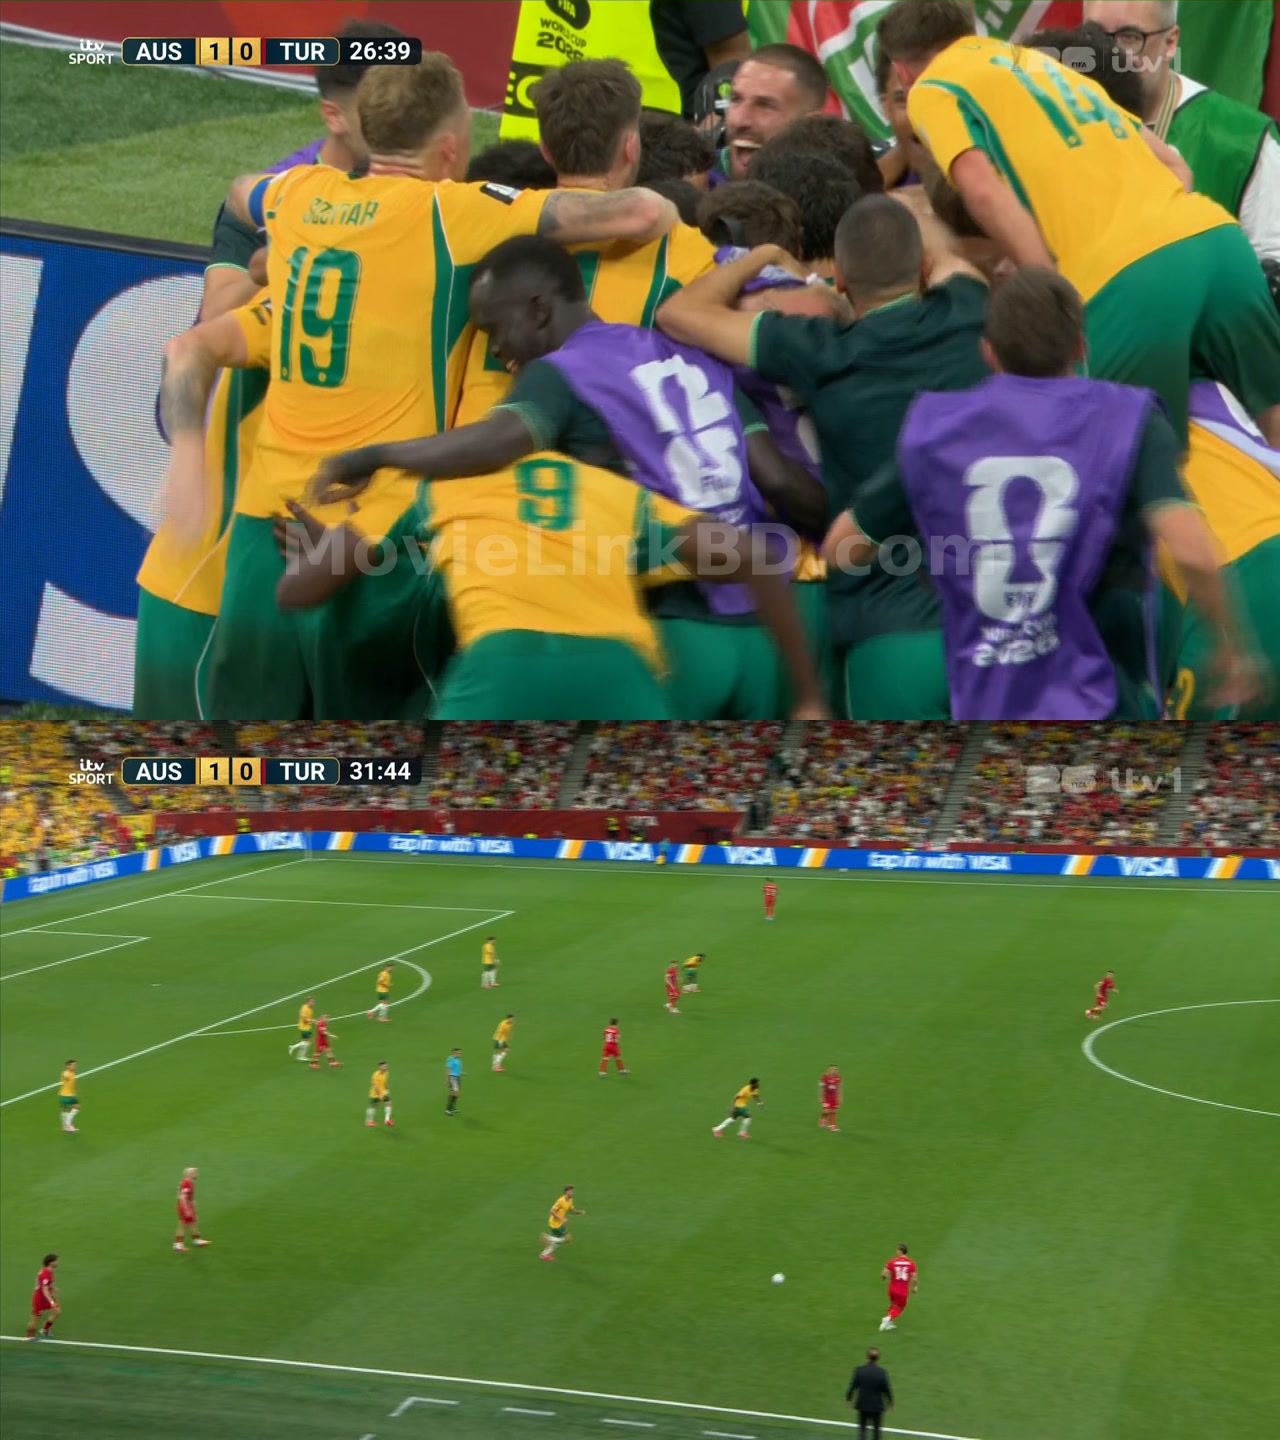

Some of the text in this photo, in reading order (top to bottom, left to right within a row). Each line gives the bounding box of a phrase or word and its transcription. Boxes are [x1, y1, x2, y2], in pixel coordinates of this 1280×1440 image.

[570, 34, 587, 49] CUP
[990, 55, 1129, 148] 14
[280, 245, 362, 389] 19
[515, 458, 574, 531] 9
[252, 831, 306, 851] VISA
[475, 839, 514, 854] VISA
[602, 841, 654, 860] VISA
[722, 846, 777, 865] VISA
[967, 854, 1012, 870] VISA
[1116, 857, 1179, 877] VISA
